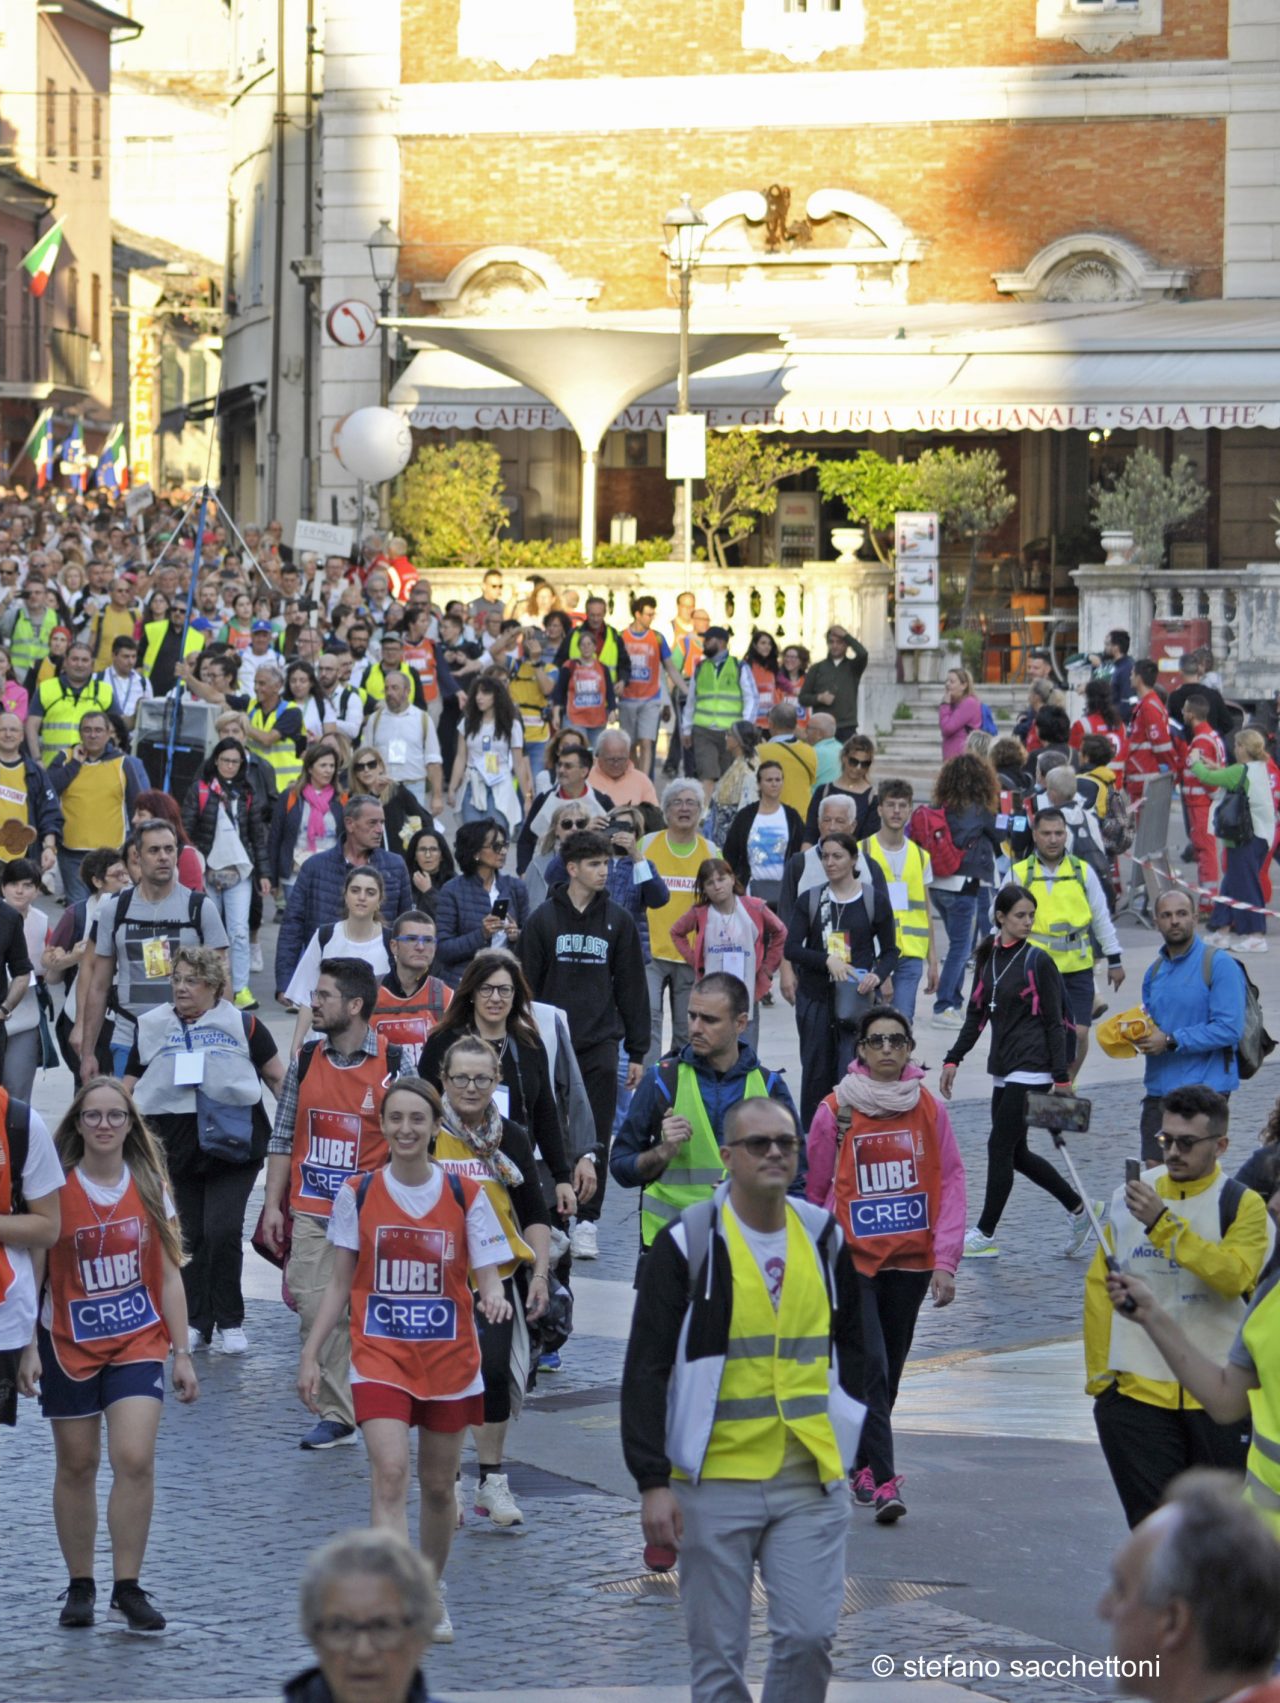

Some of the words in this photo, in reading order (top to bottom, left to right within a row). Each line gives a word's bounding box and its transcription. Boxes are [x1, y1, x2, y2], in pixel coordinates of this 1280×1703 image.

[1120, 406, 1191, 425] SALA
[1200, 404, 1265, 424] THE'
[171, 1030, 224, 1043] Maerata
[203, 1035, 238, 1047] Loreto
[309, 1135, 355, 1168] LUBE
[306, 1170, 348, 1192] CRE
[860, 1160, 916, 1193] LUBE
[857, 1200, 923, 1224] CREO
[381, 1230, 440, 1241] CUCINE
[83, 1249, 138, 1291] LUBE
[379, 1259, 438, 1292] LUBE
[78, 1292, 146, 1326] CREO
[374, 1303, 448, 1327] CREO
